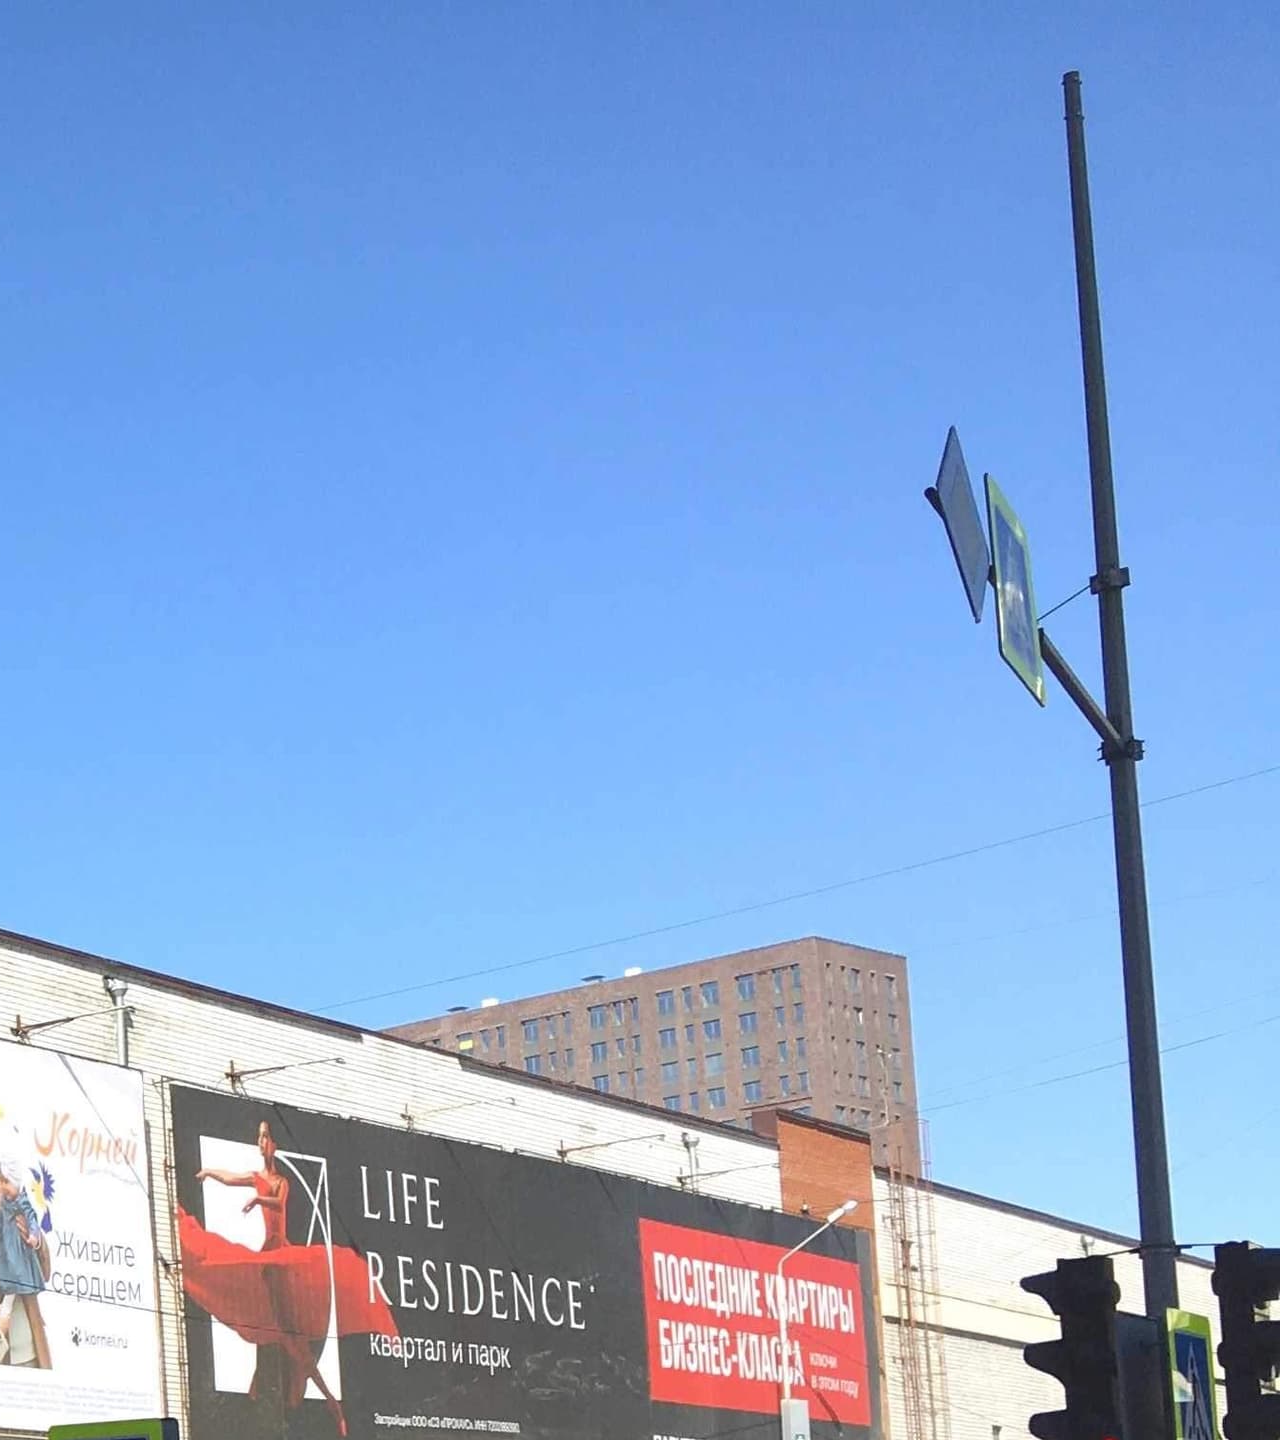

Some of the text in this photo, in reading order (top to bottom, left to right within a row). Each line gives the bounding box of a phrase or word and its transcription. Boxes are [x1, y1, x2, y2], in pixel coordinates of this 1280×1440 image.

[34, 1111, 138, 1174] Корней
[360, 1165, 444, 1229] LIFE
[55, 1230, 136, 1267] Живите
[51, 1271, 142, 1303] сердцем
[366, 1251, 586, 1330] RESIDENCE
[652, 1251, 856, 1334] ПОСЛЕДНИЕ КВАРТИРЫ
[370, 1333, 511, 1375] квартал и парк
[658, 1319, 805, 1387] БИЗНЕС-КЛАССА
